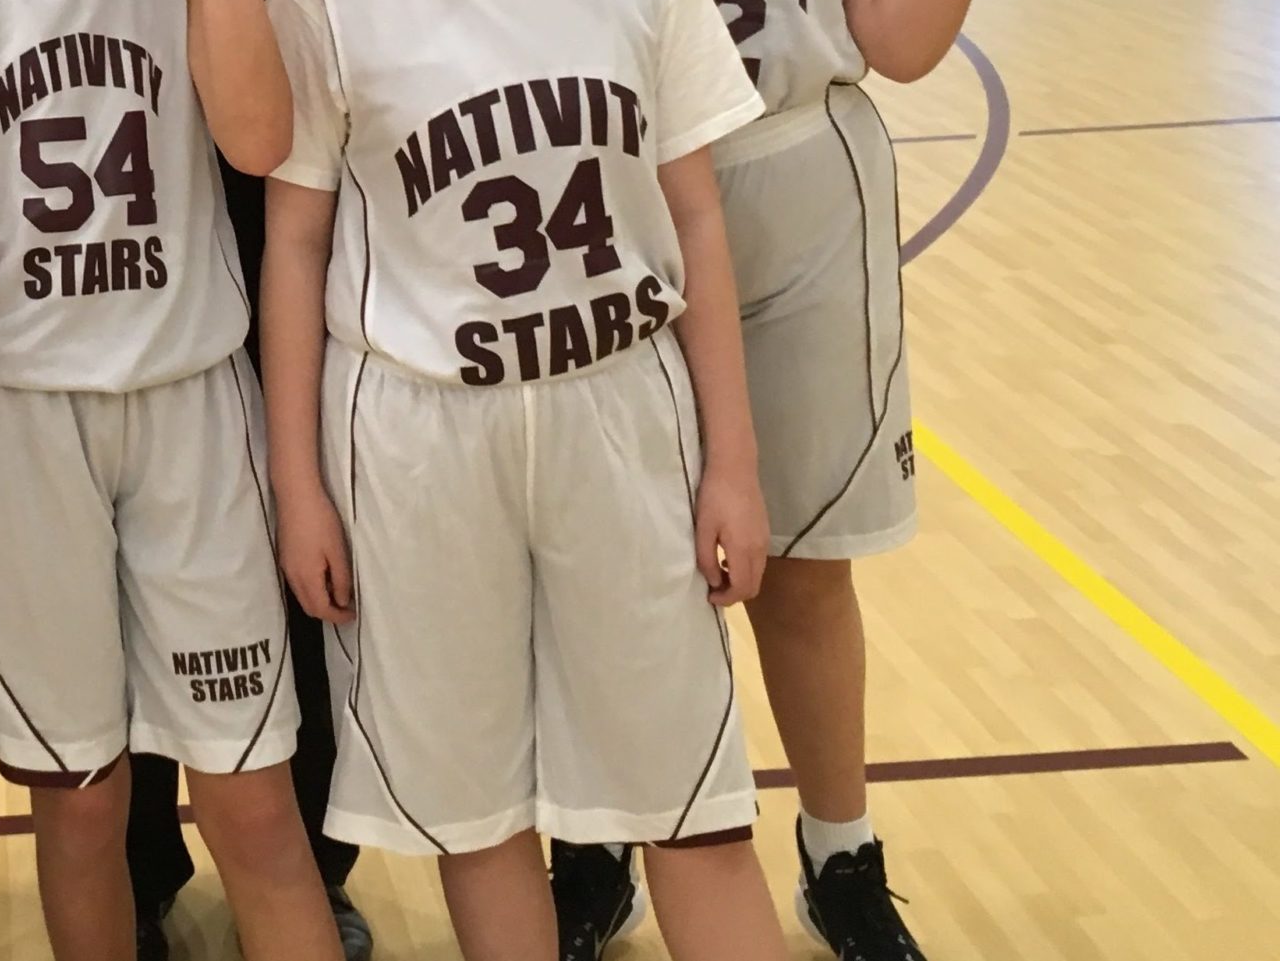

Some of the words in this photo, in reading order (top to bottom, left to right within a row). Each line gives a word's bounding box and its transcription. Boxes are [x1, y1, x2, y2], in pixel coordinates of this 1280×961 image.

[19, 110, 158, 233] 54
[23, 236, 168, 300] STARS
[461, 157, 622, 299] 34
[454, 275, 669, 386] STARS
[172, 638, 271, 676] NATIVITY
[190, 671, 265, 703] STARS
